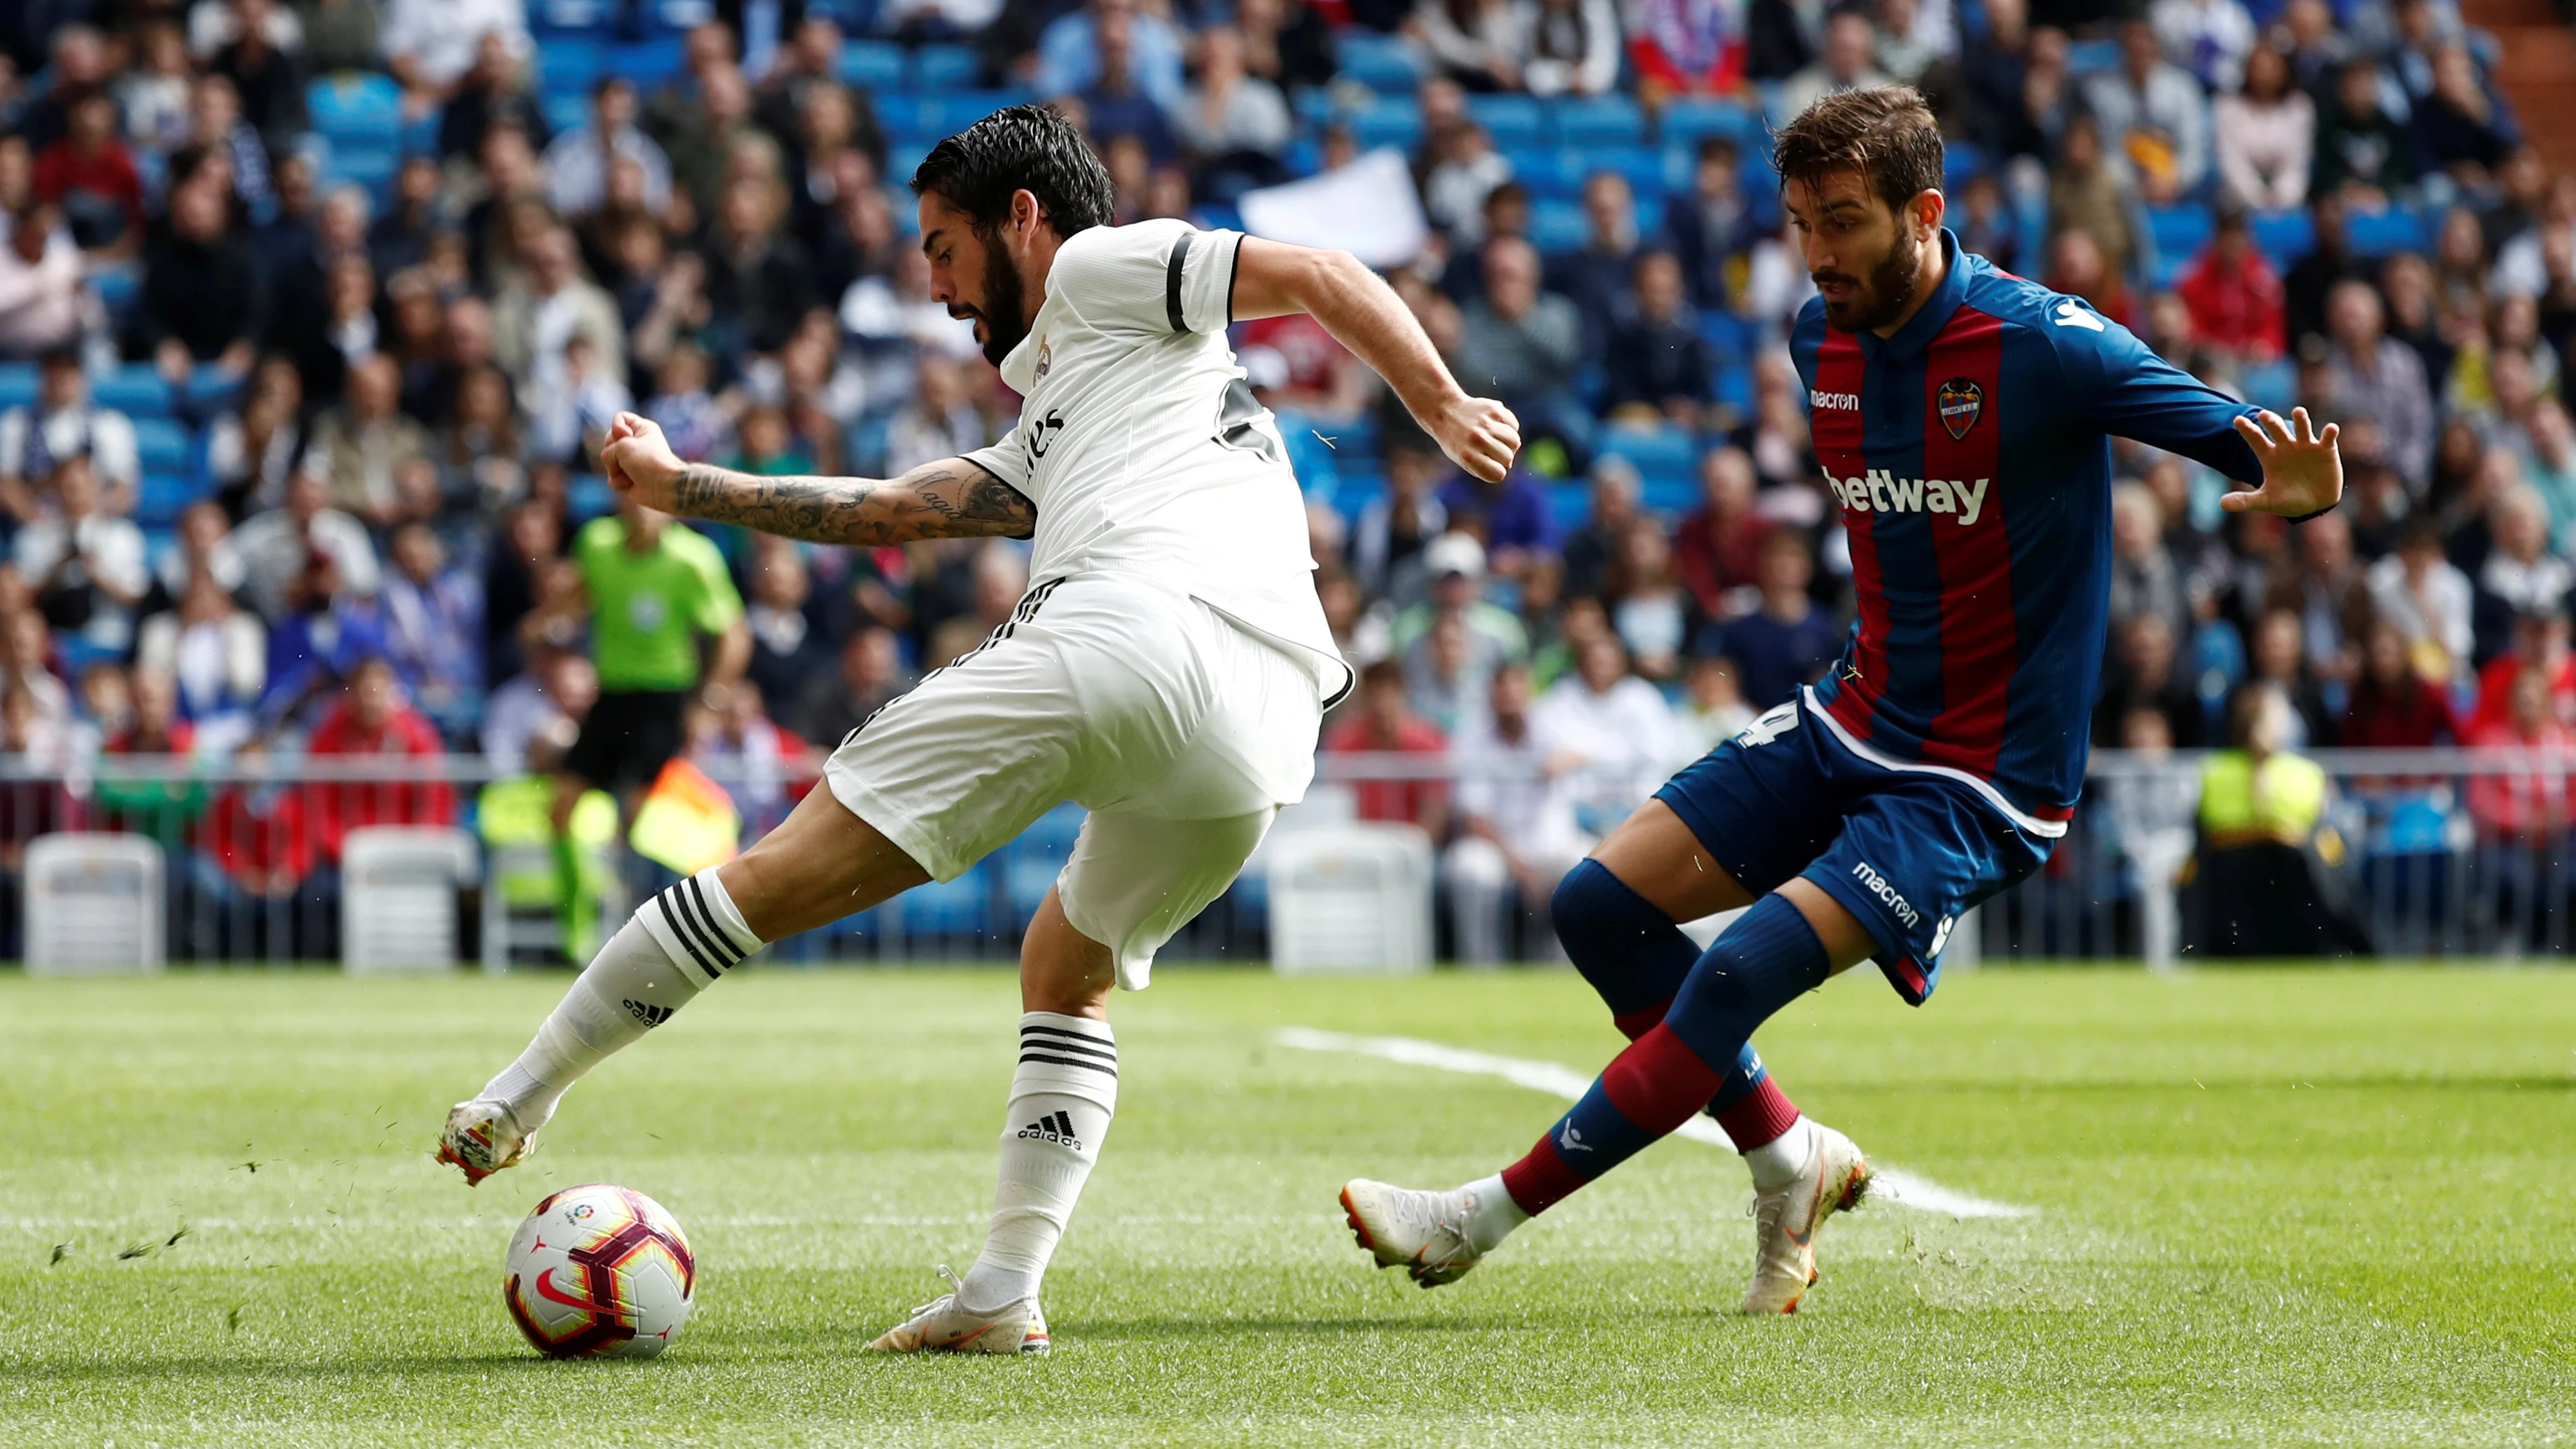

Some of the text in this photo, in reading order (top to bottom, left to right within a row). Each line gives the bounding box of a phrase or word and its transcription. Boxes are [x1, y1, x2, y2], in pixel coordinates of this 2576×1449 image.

[1810, 389, 1859, 411] macron
[1822, 466, 1990, 526] betway
[1852, 861, 1920, 929] macron
[1018, 1128, 1082, 1151] adidas
